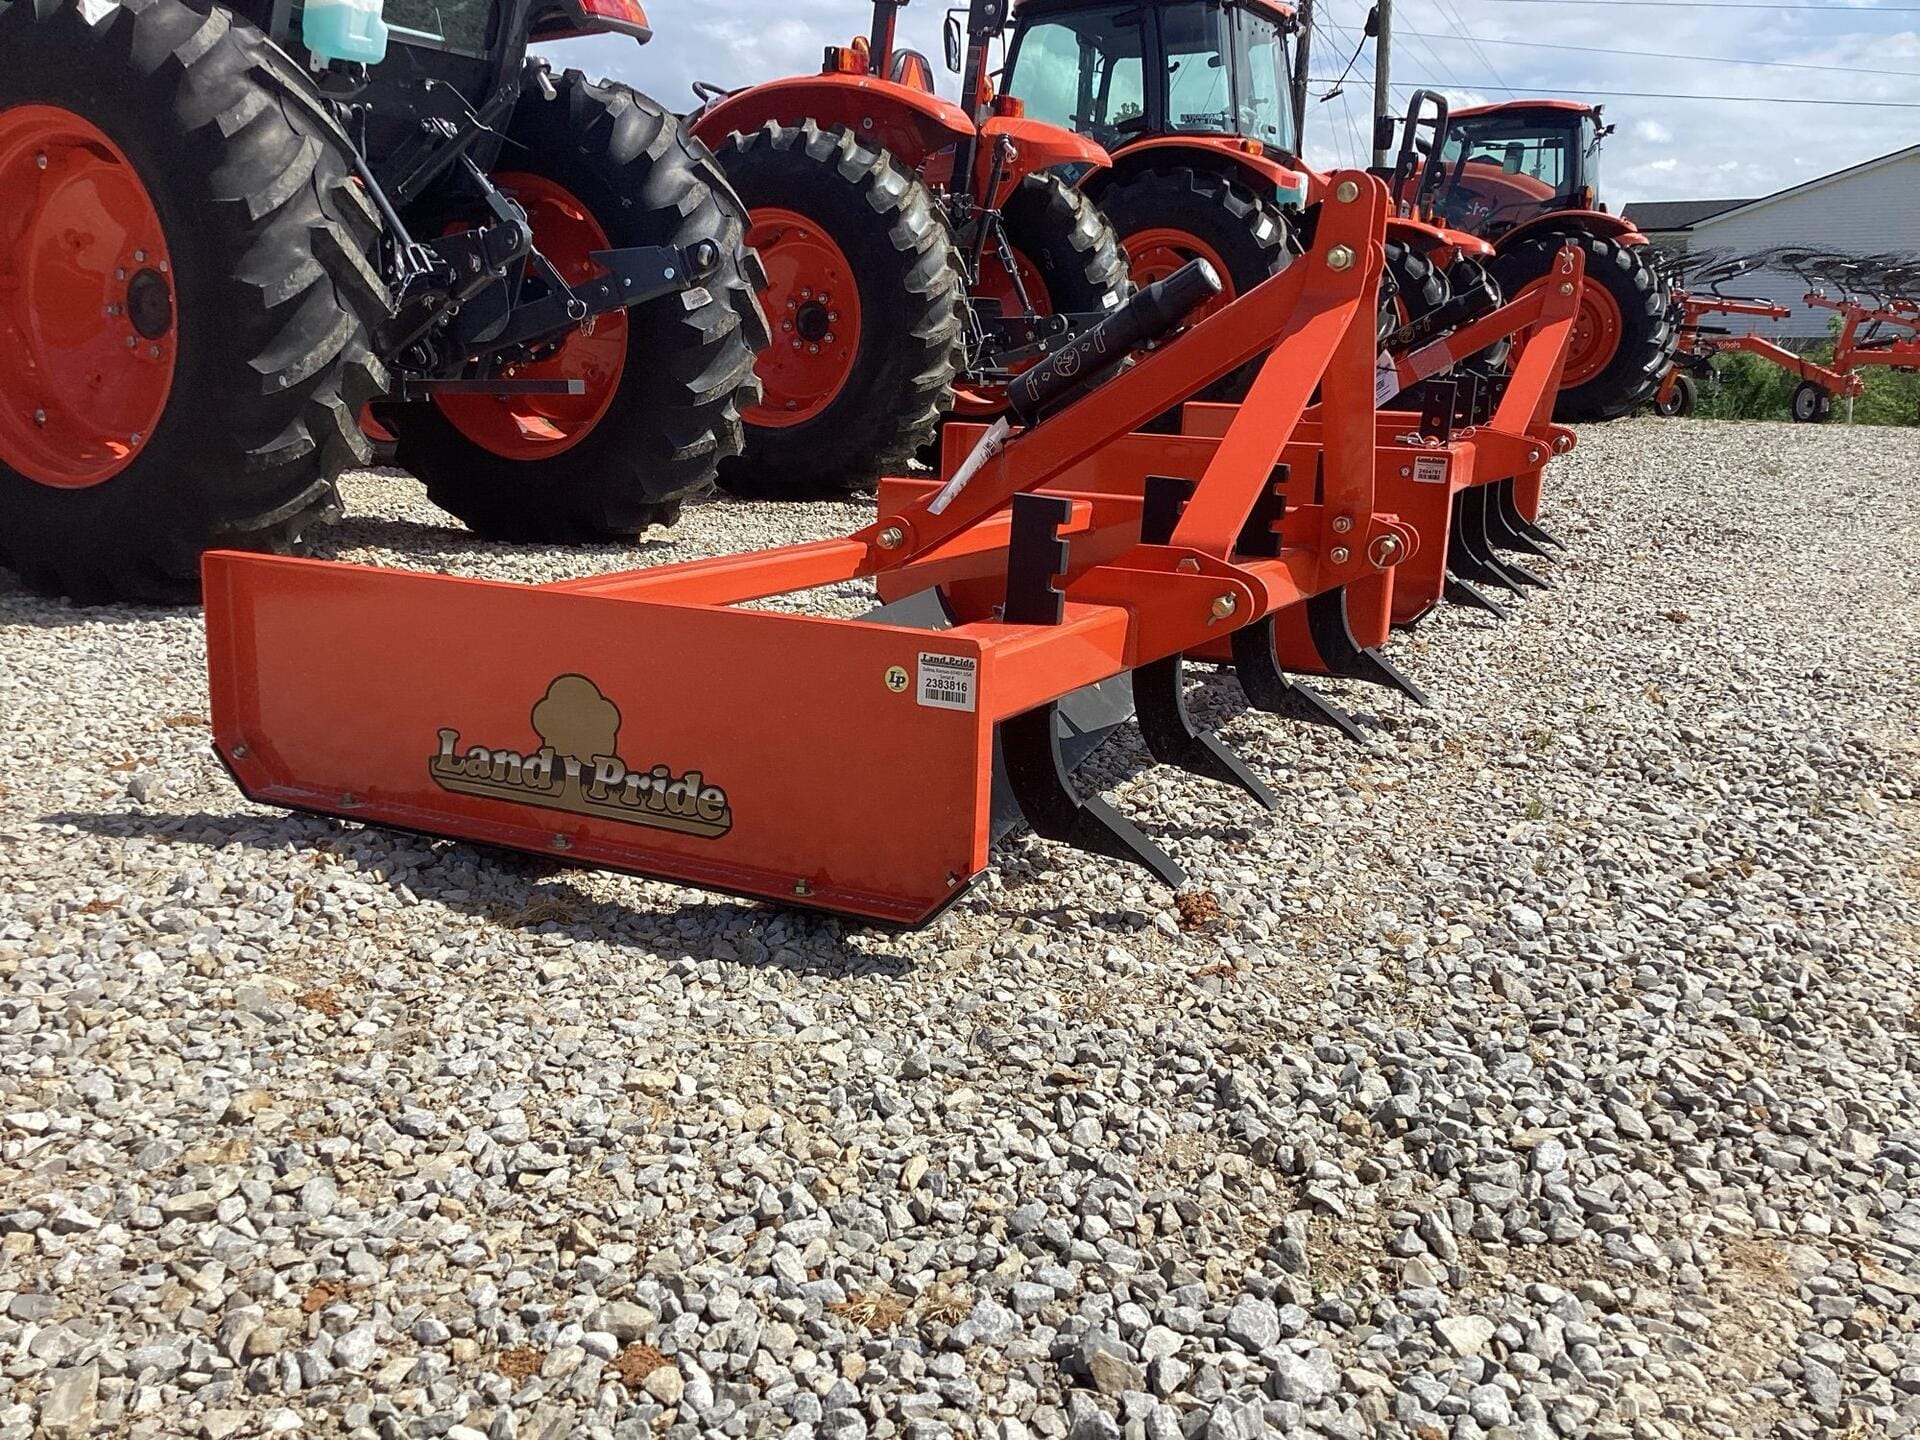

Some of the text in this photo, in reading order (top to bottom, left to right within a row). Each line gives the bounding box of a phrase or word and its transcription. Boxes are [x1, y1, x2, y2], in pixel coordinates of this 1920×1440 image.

[921, 654, 976, 668] Land Pride
[925, 677, 968, 692] 2383816
[437, 728, 728, 821] Land Pride
